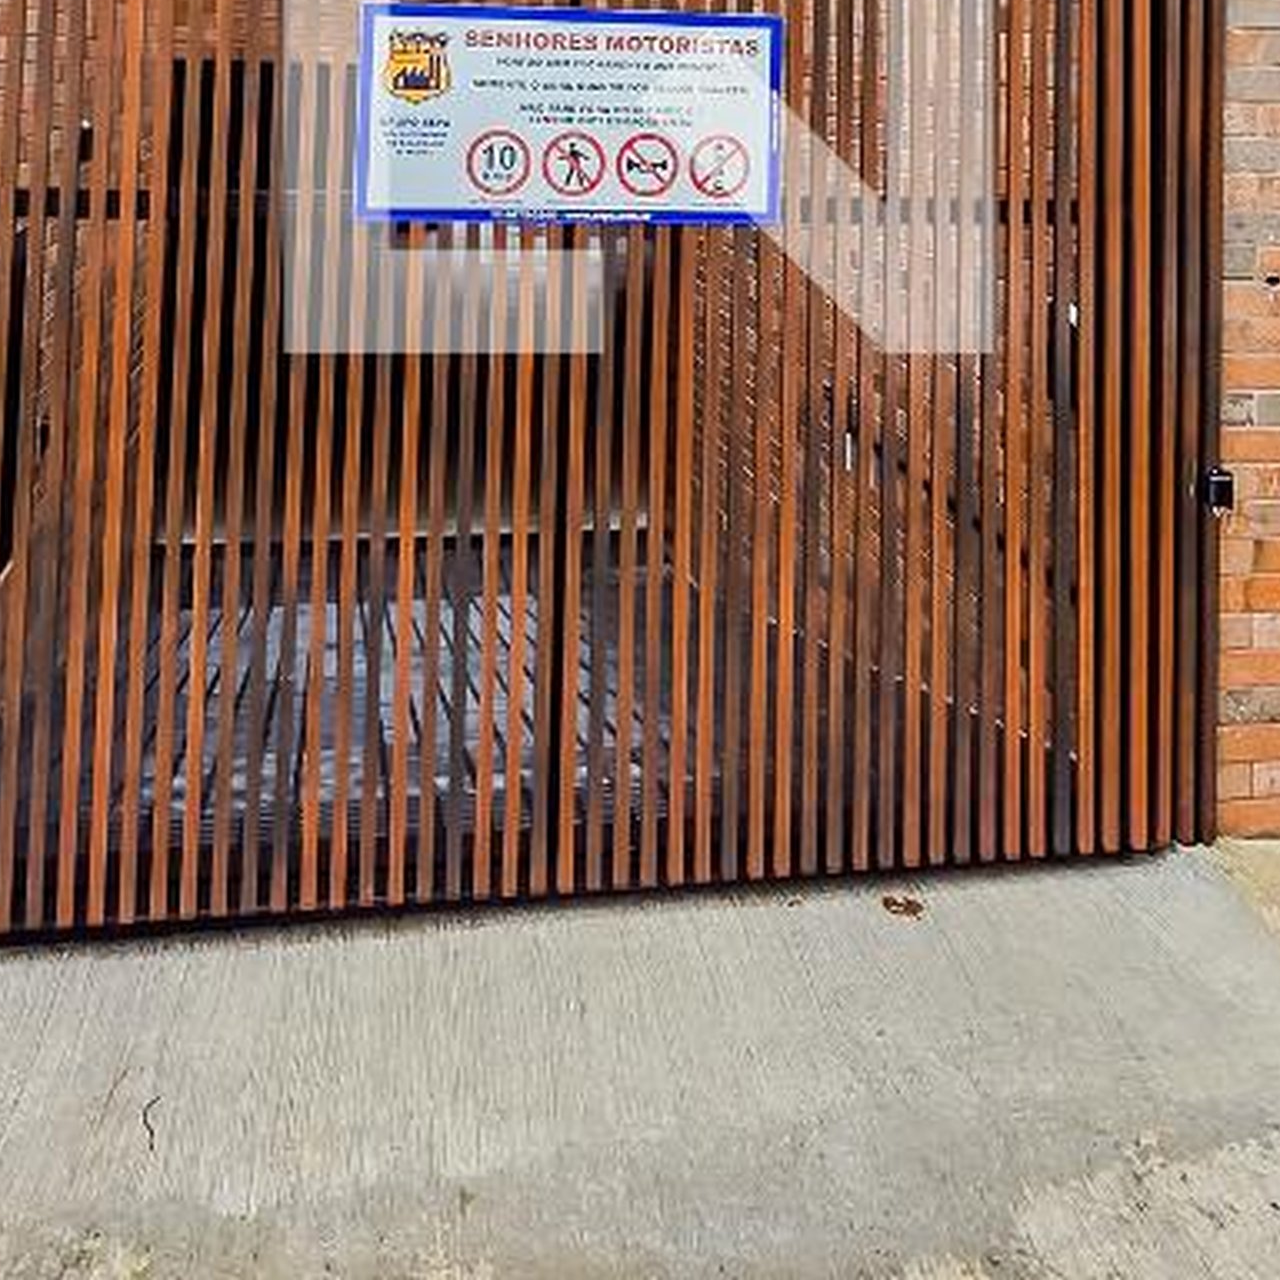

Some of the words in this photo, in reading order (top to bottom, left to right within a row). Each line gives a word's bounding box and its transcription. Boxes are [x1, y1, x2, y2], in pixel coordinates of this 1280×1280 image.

[464, 29, 599, 53] SENHORES
[605, 31, 760, 59] MOTORISTAS
[482, 144, 517, 172] 10
